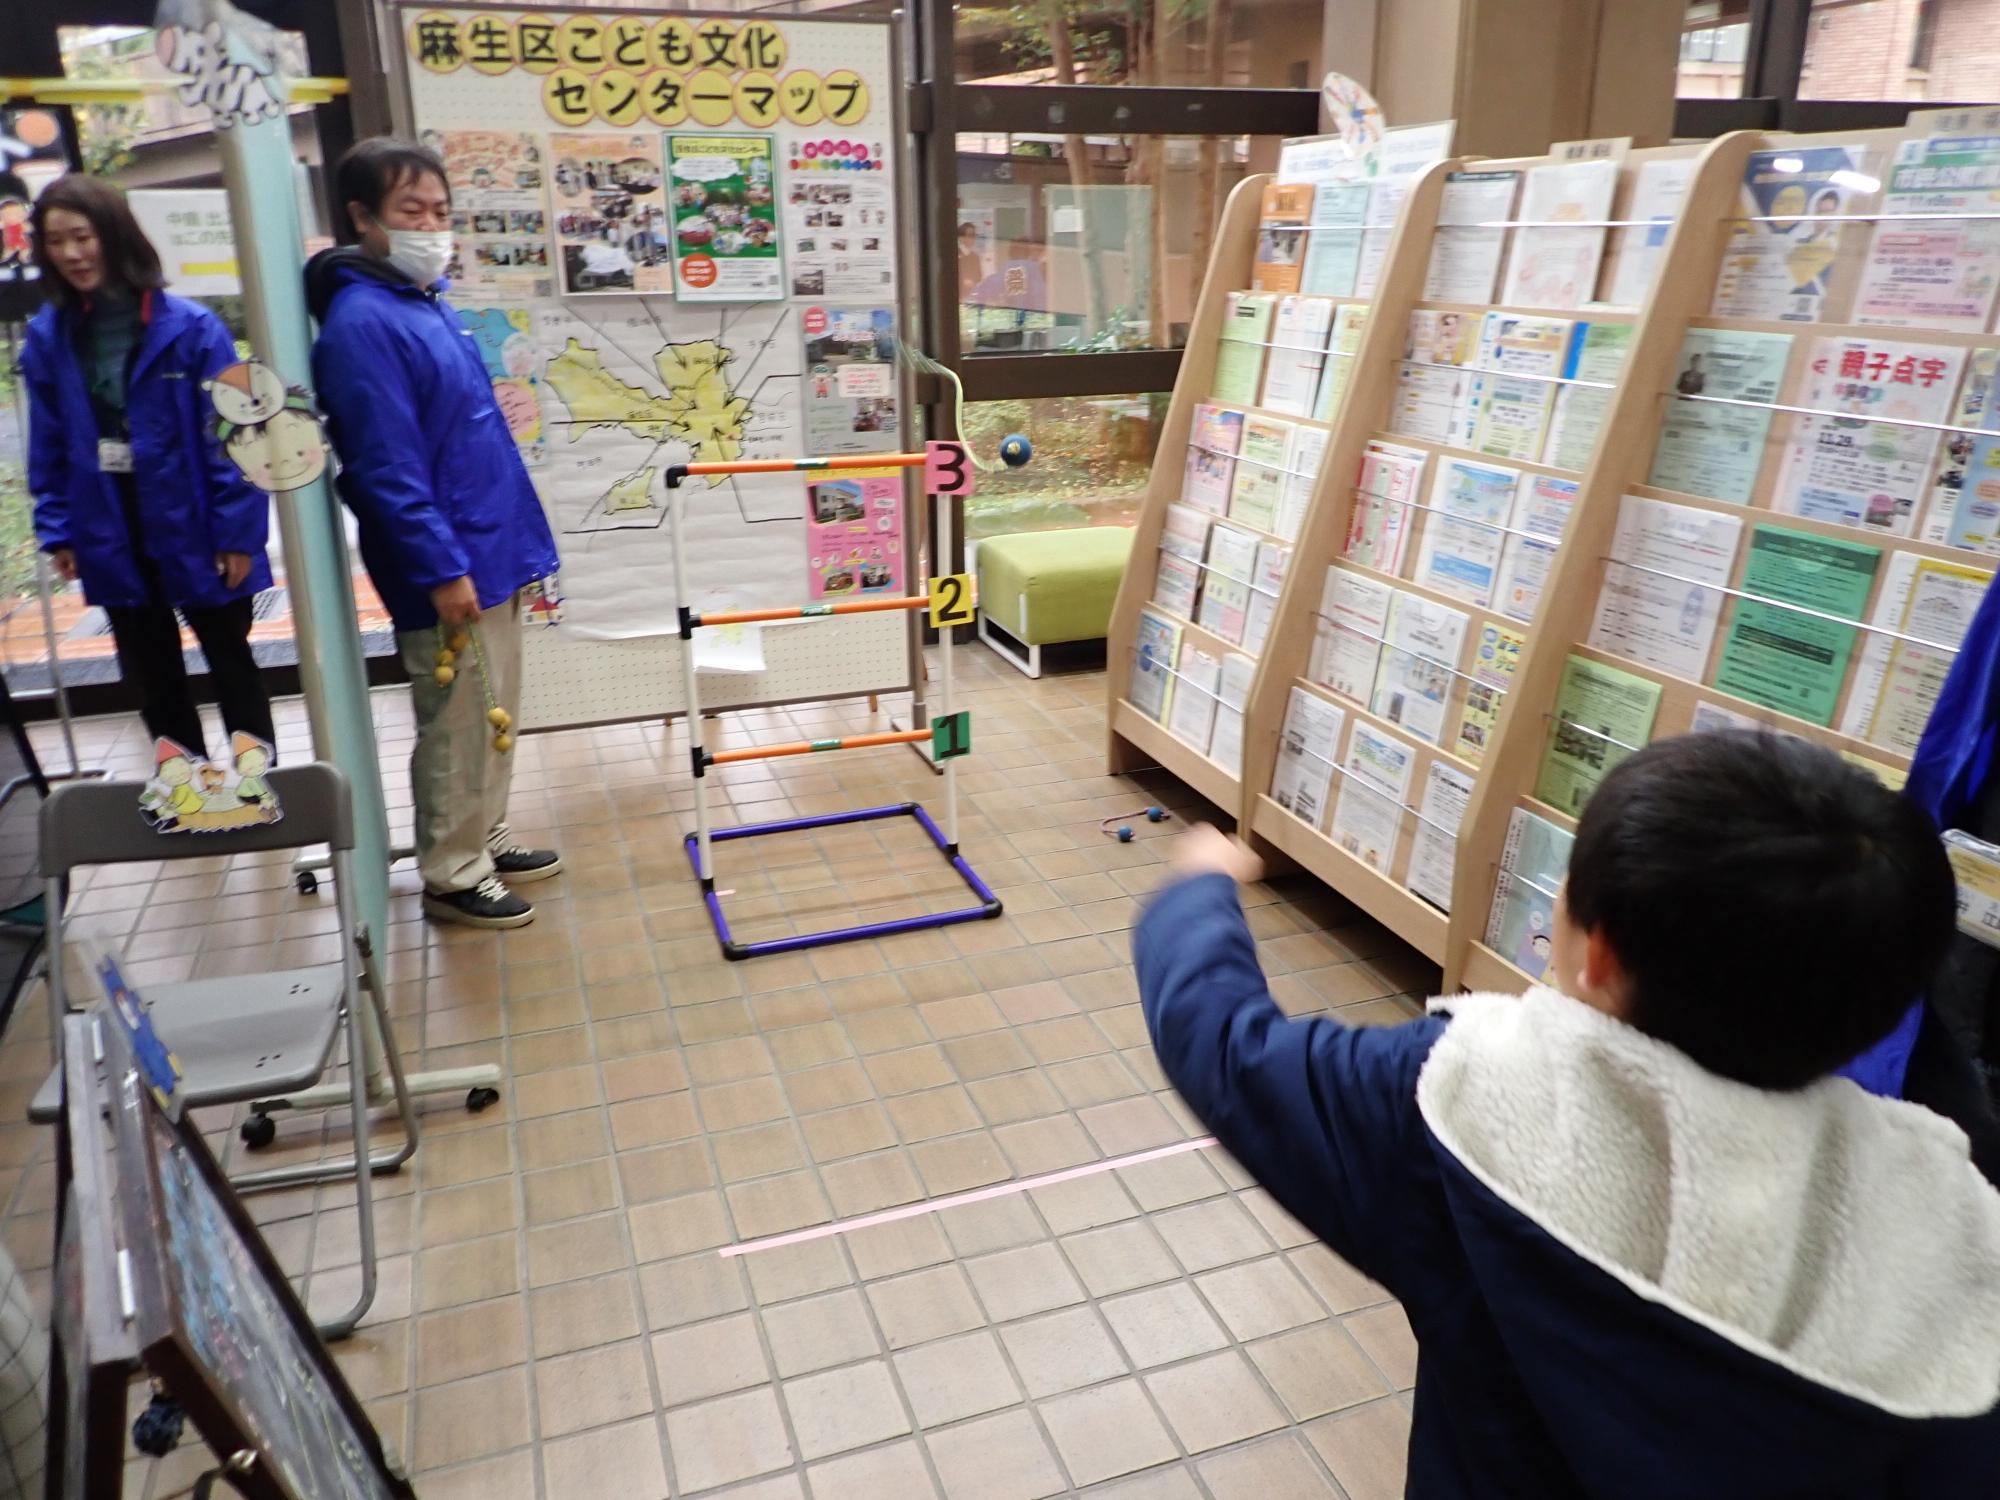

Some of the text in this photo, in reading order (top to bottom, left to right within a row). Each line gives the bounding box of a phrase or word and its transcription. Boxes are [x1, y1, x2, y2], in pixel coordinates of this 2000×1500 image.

[417, 21, 780, 68] 麻生区こども文化
[551, 75, 861, 127] センターマップ
[1840, 350, 1947, 388] 親子点字
[936, 443, 965, 491] 3
[937, 578, 967, 622] 2
[937, 714, 968, 758] 1
